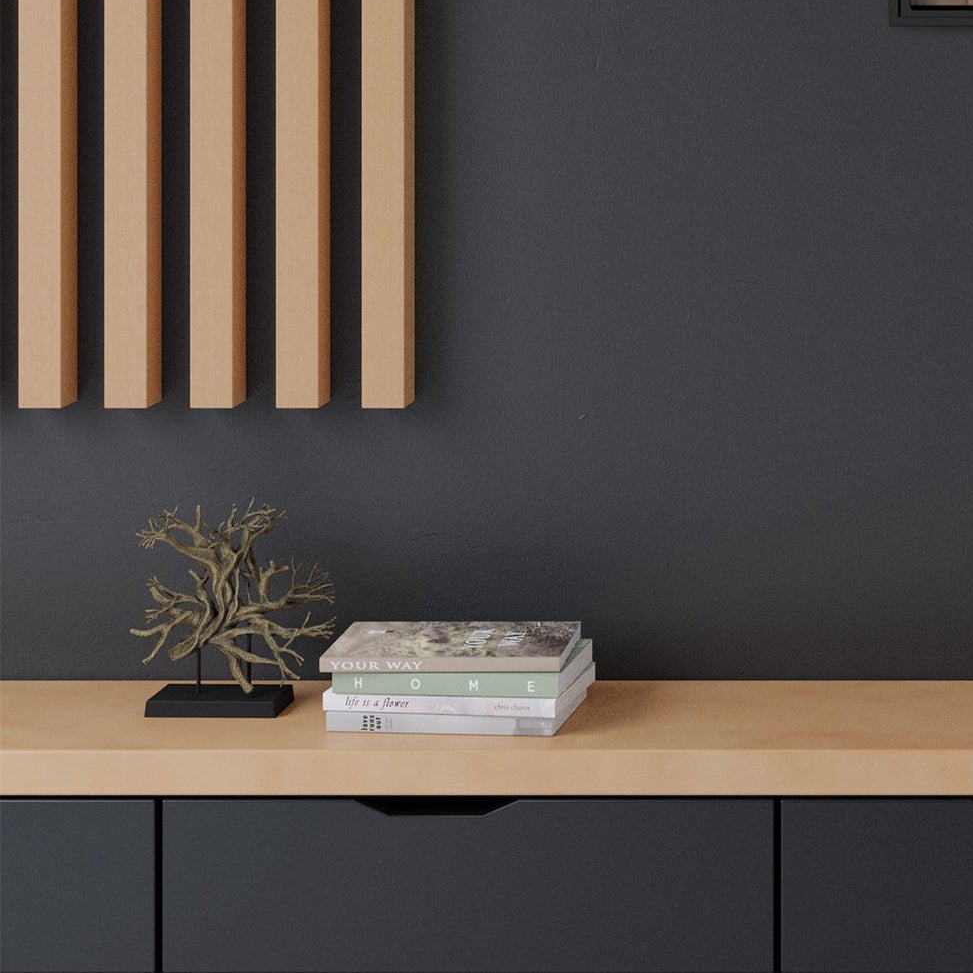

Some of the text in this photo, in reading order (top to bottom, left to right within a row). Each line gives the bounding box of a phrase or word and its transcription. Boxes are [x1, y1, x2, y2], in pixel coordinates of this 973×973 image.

[330, 661, 423, 670] YOUR WAY
[354, 677, 535, 692] HOME
[345, 696, 359, 709] life
[363, 698, 370, 707] is
[380, 697, 409, 710] flower
